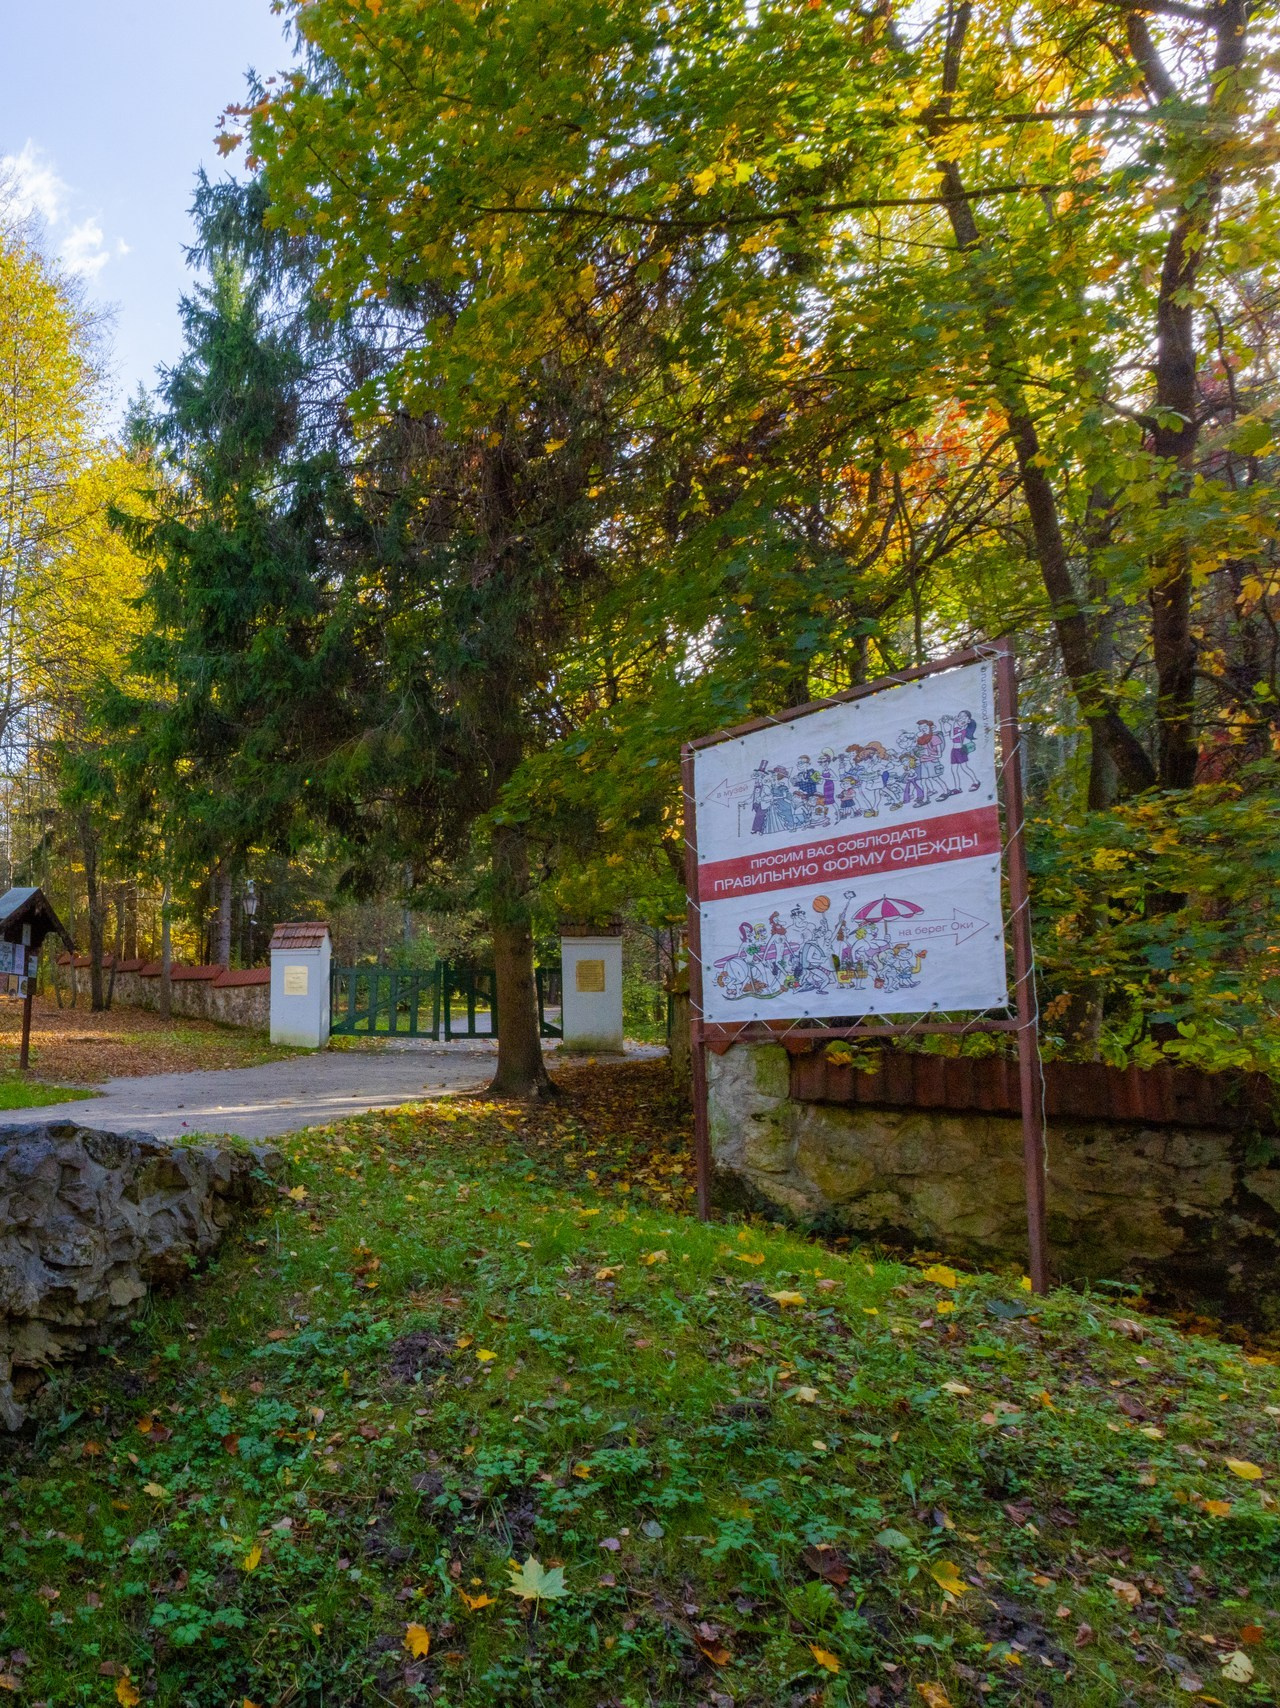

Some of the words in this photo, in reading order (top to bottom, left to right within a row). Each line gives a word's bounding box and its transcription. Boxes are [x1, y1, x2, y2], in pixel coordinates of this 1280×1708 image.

[723, 784, 749, 796] музей
[714, 863, 819, 892] ПРАВИЛЬНУЮ
[822, 850, 887, 873] ФОРМУ
[890, 833, 979, 862] ОДЕЖДЫ
[750, 850, 804, 870] ПРОСИМ
[806, 844, 835, 859] ВАС
[837, 827, 927, 853] СОБЛЮДАТЬ
[898, 928, 912, 937] на
[914, 924, 948, 936] берег
[950, 921, 975, 931] Оки
